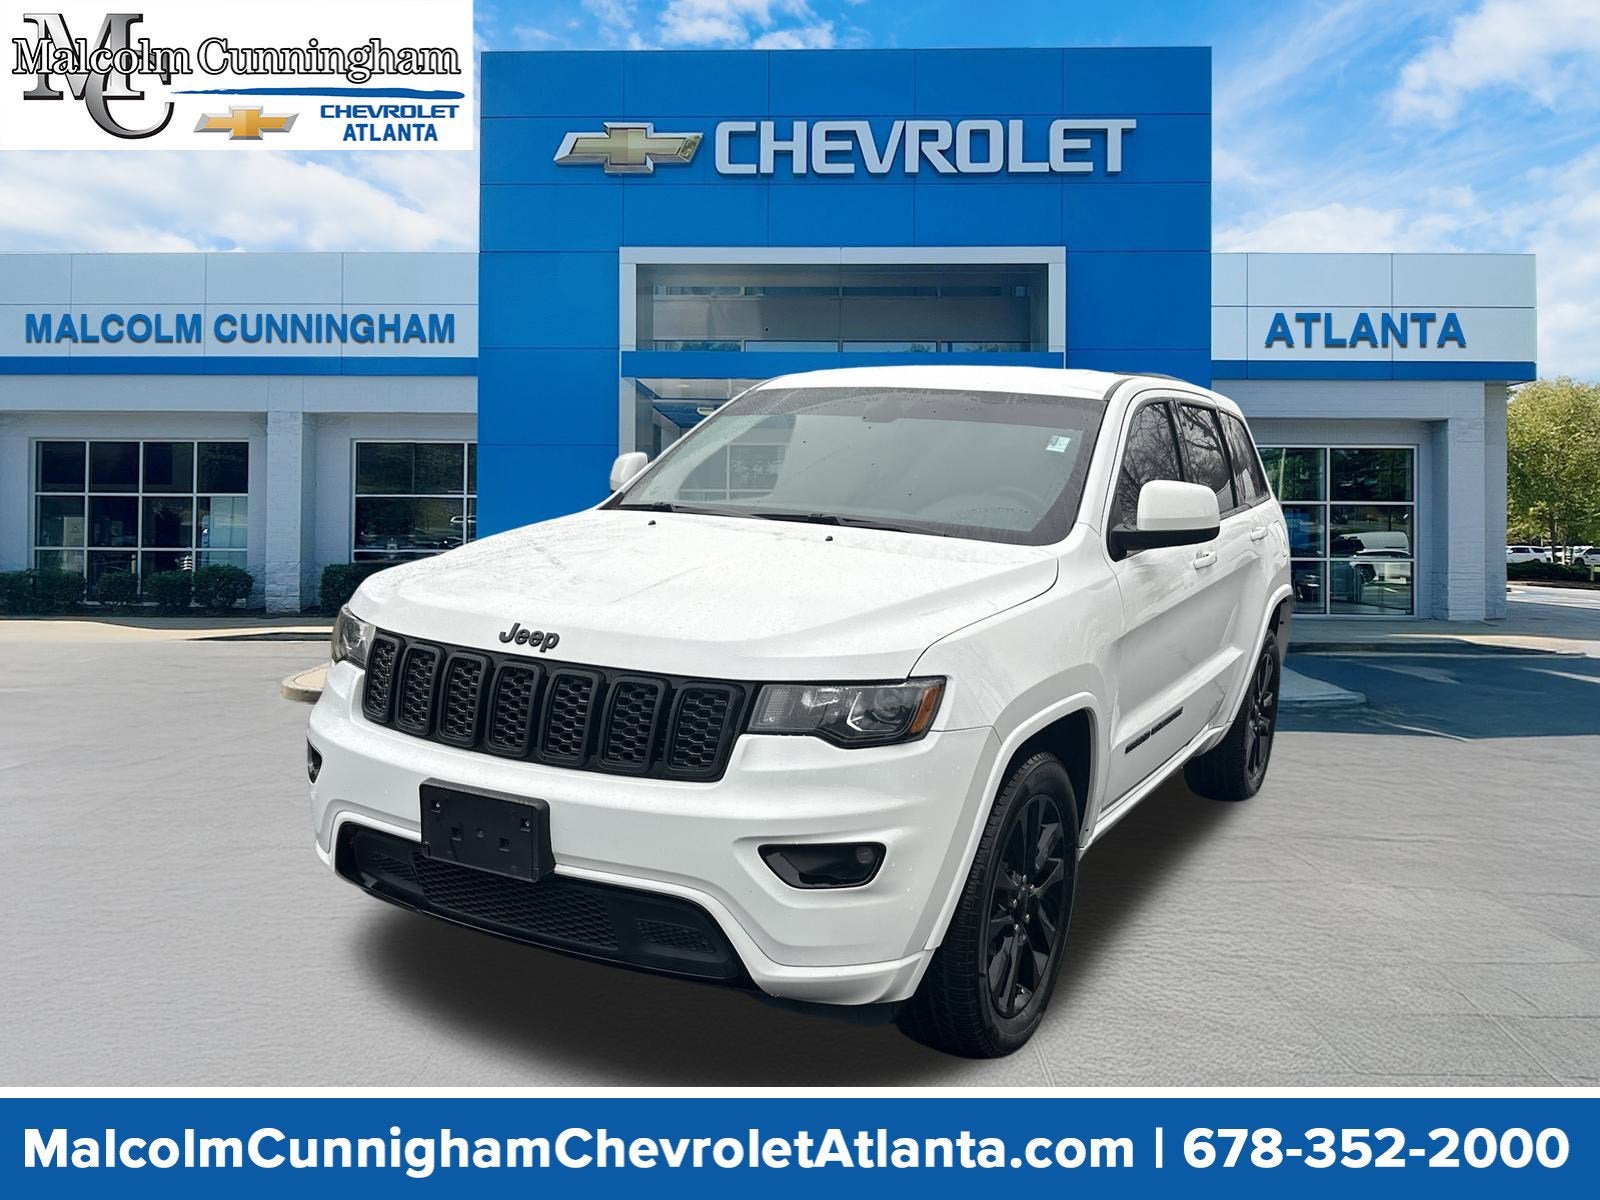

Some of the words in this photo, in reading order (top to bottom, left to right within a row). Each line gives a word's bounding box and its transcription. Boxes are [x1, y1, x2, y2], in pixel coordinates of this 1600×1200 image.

[715, 118, 1137, 175] CHEVROLET
[25, 313, 202, 343] MALCOLM
[213, 313, 456, 343] CUNNINGHAM
[1264, 312, 1467, 348] ATLANTA
[498, 622, 561, 652] Jeep
